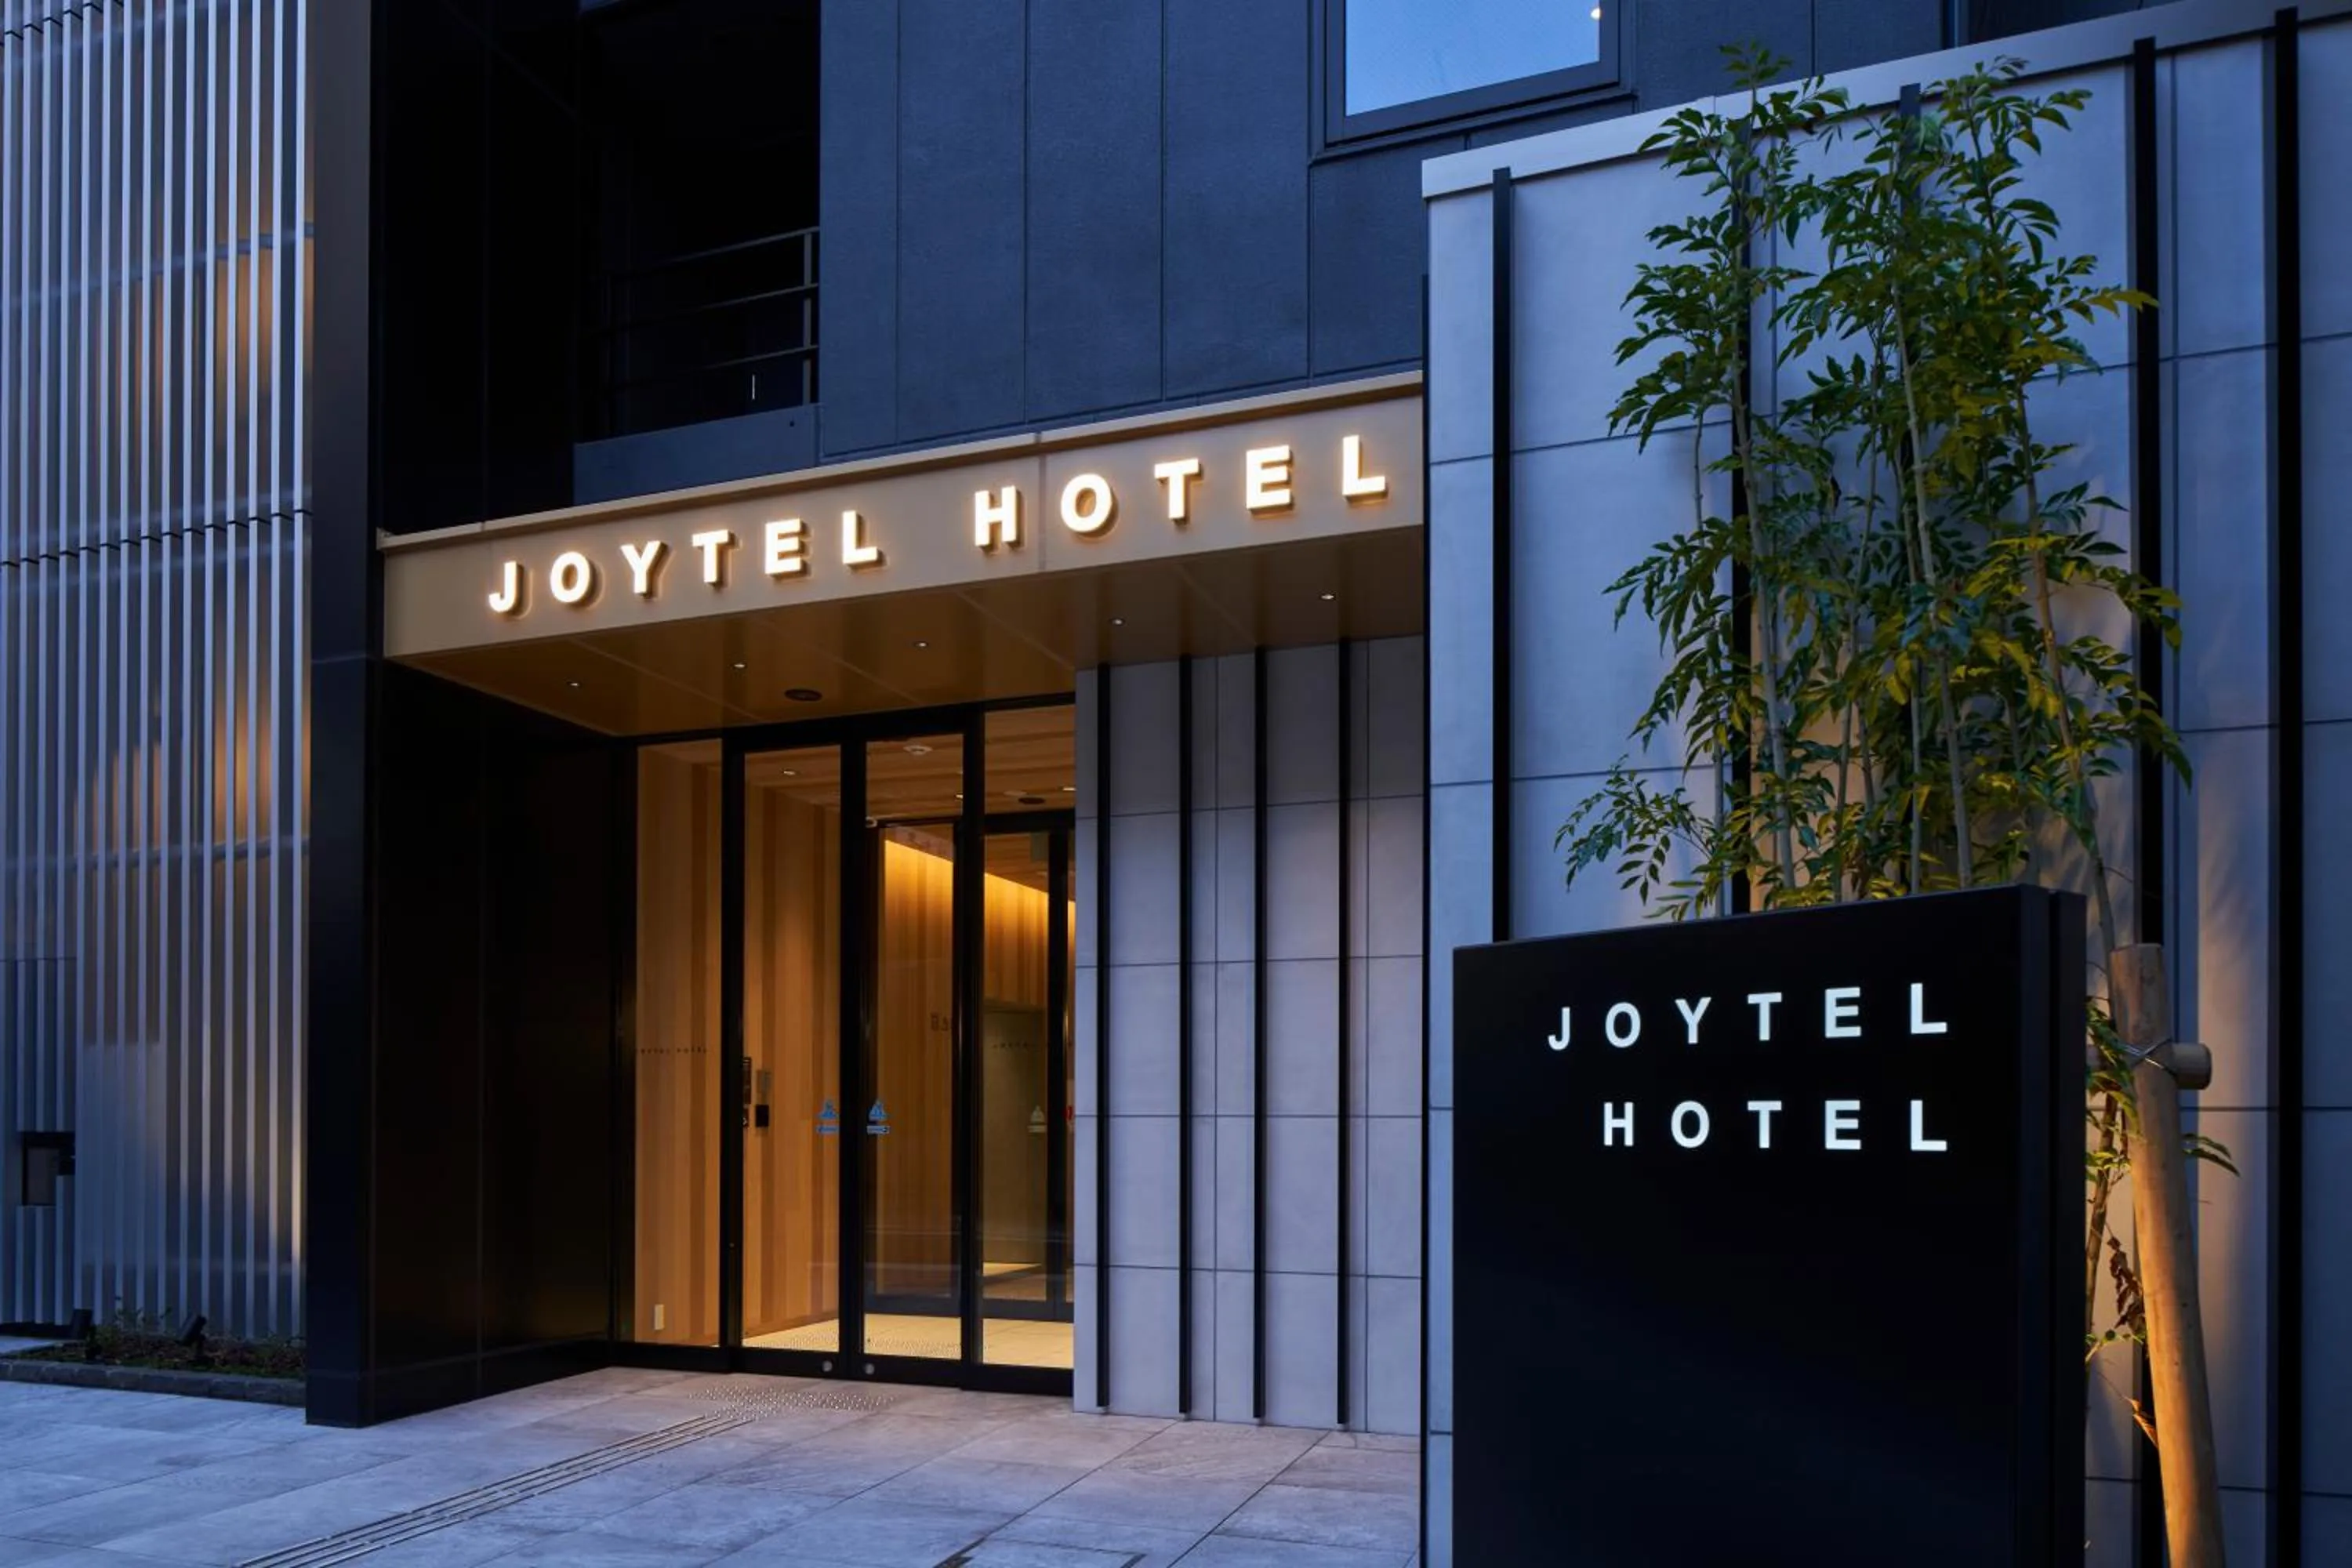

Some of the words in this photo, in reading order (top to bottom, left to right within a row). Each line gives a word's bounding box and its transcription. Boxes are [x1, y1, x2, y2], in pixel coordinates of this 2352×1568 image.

[488, 509, 879, 614] JOYTEL
[972, 434, 1387, 547] HOTEL
[1548, 982, 1947, 1051] JOYTEL
[1603, 1100, 1947, 1152] HOTEL
